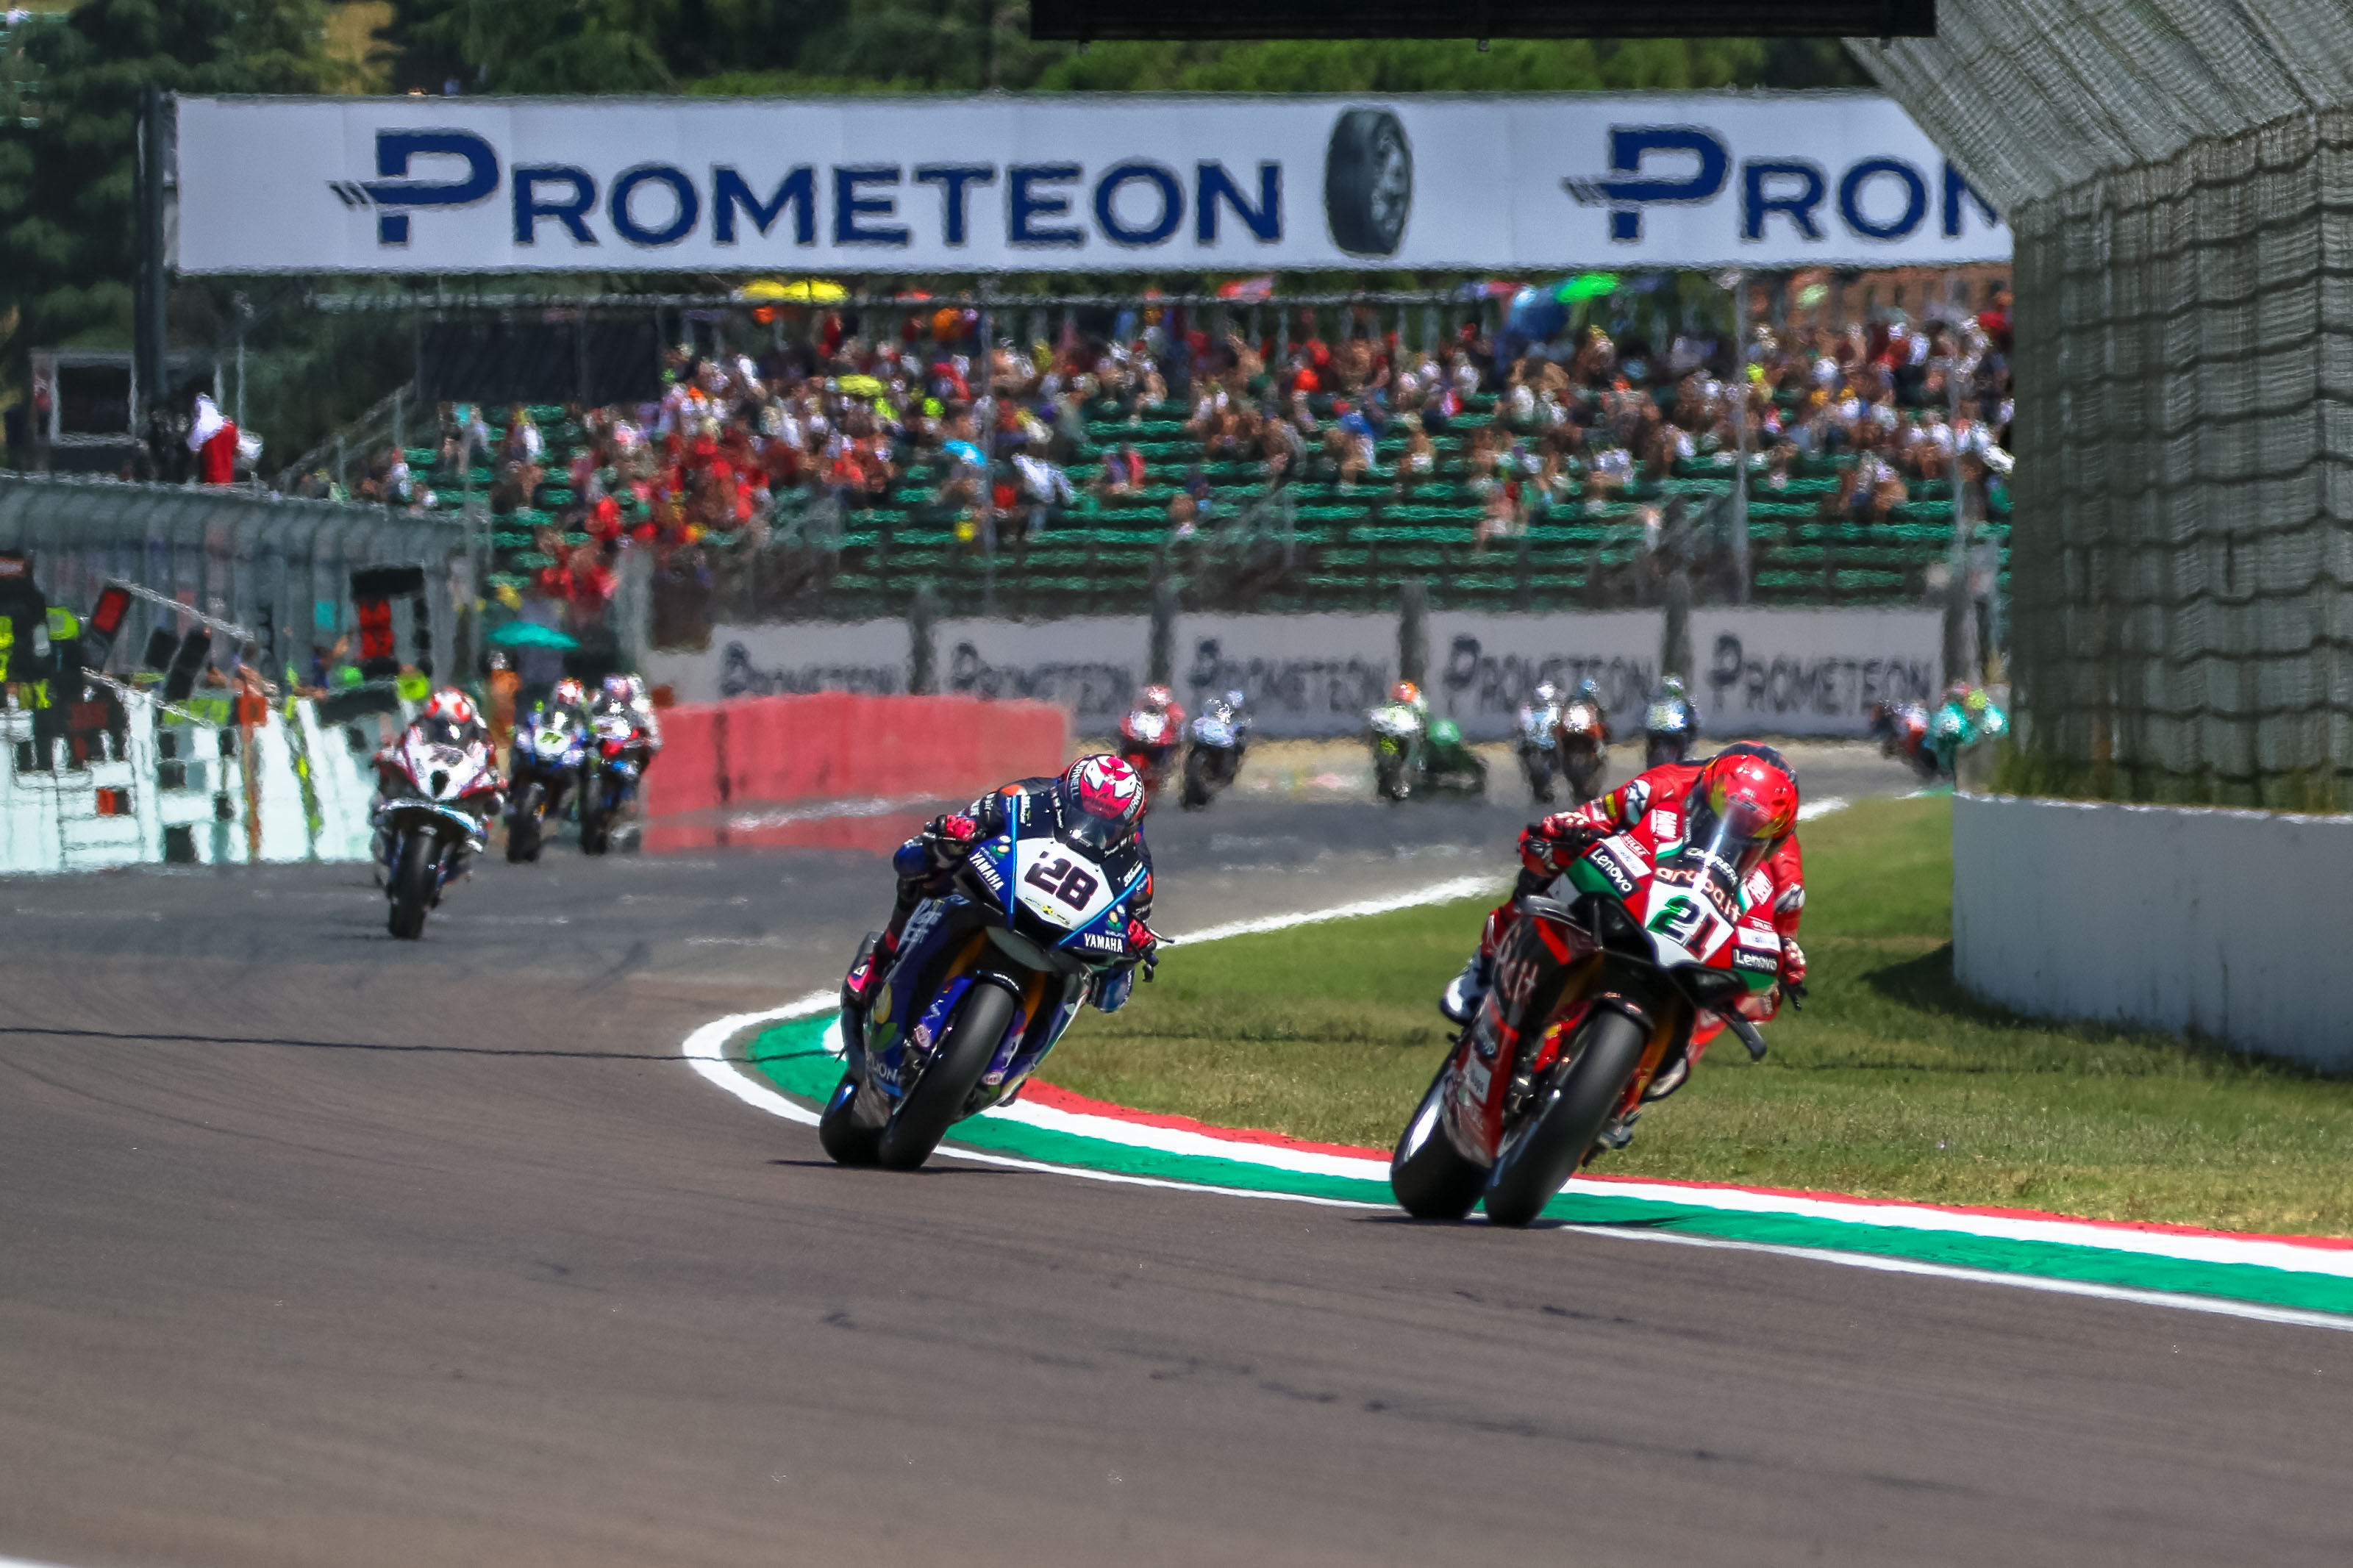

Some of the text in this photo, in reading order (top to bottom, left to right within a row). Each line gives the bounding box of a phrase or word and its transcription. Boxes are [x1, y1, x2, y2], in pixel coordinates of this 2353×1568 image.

[329, 126, 1283, 247] PROMETEON
[969, 851, 1004, 891] YAMAHA
[1024, 851, 1099, 912] 28
[1590, 848, 1632, 892] Lenovo
[1084, 933, 1123, 953] YAMAHA
[1646, 895, 1719, 962] 21
[1733, 949, 1778, 971] Lenovo
